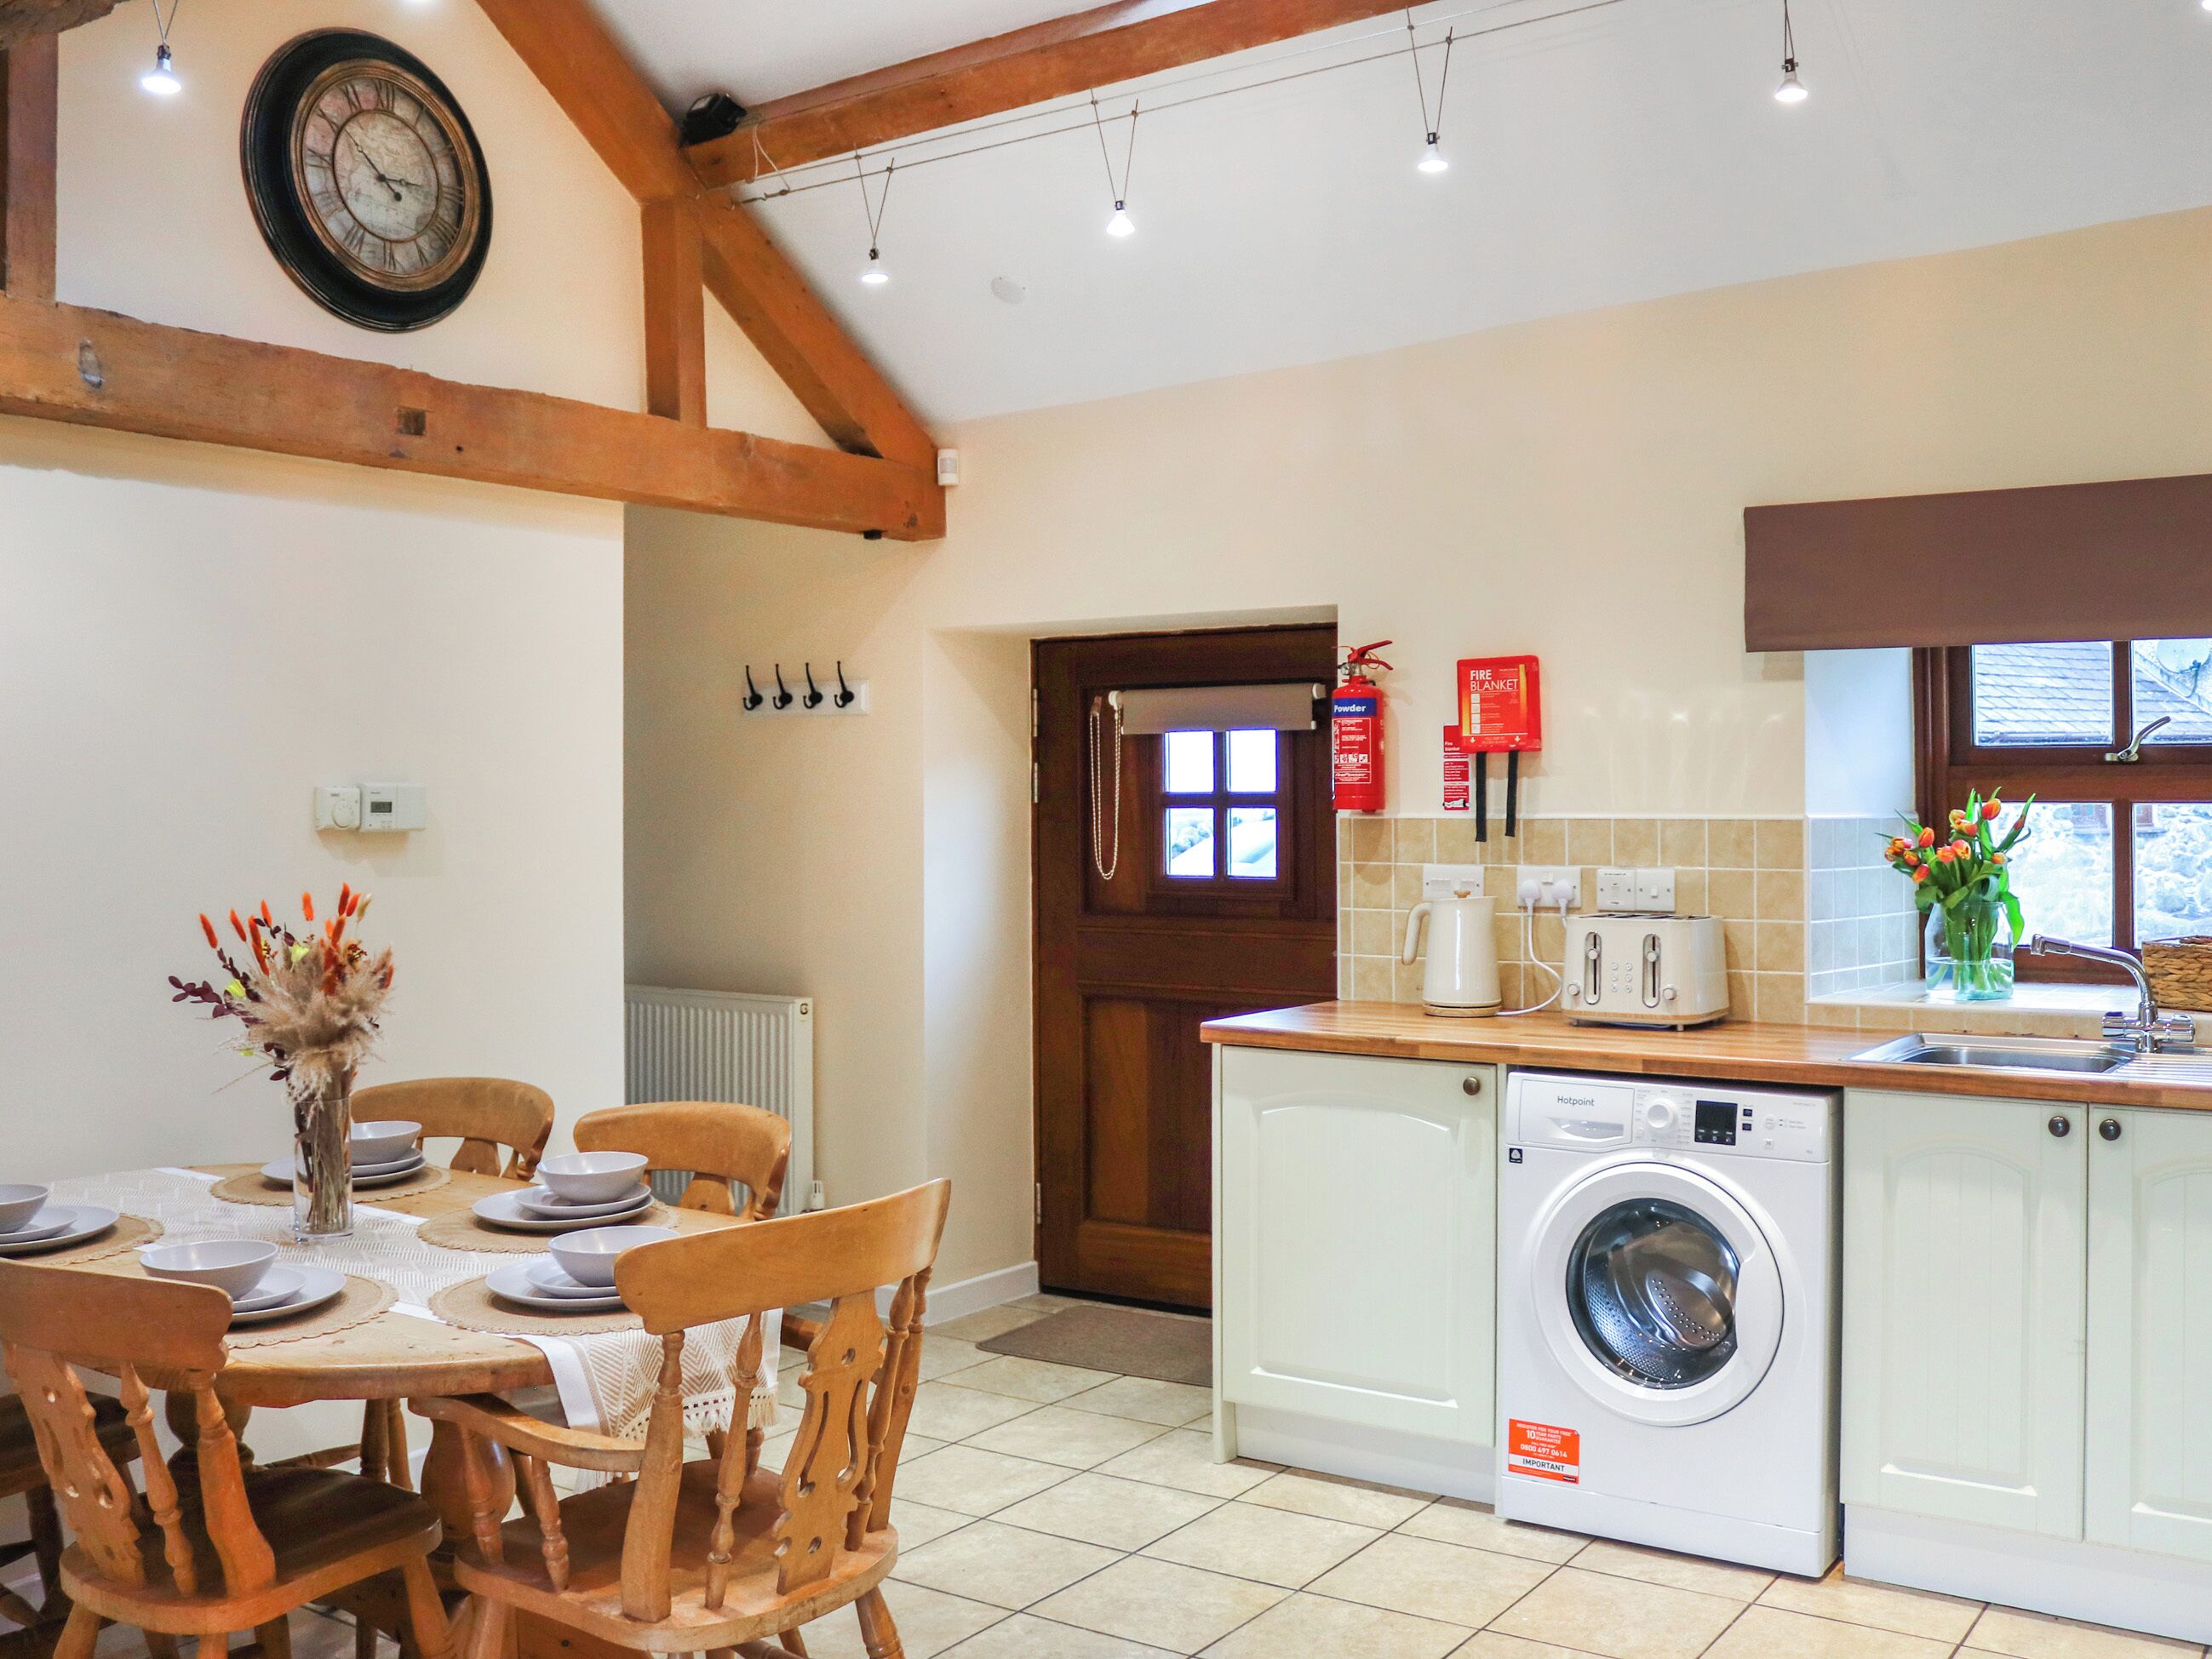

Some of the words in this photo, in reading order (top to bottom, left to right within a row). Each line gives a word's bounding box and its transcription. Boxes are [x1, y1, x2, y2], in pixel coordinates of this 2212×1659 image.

[1470, 669, 1493, 680] FIRE
[1470, 678, 1519, 691] BLANKET
[1334, 704, 1367, 712] Powder
[1556, 1096, 1595, 1107] Hotpoint
[1526, 1430, 1536, 1439] 10
[1520, 1444, 1537, 1452] 0800
[1550, 1450, 1567, 1458] 0614
[1522, 1457, 1565, 1472] IMPORTANT
